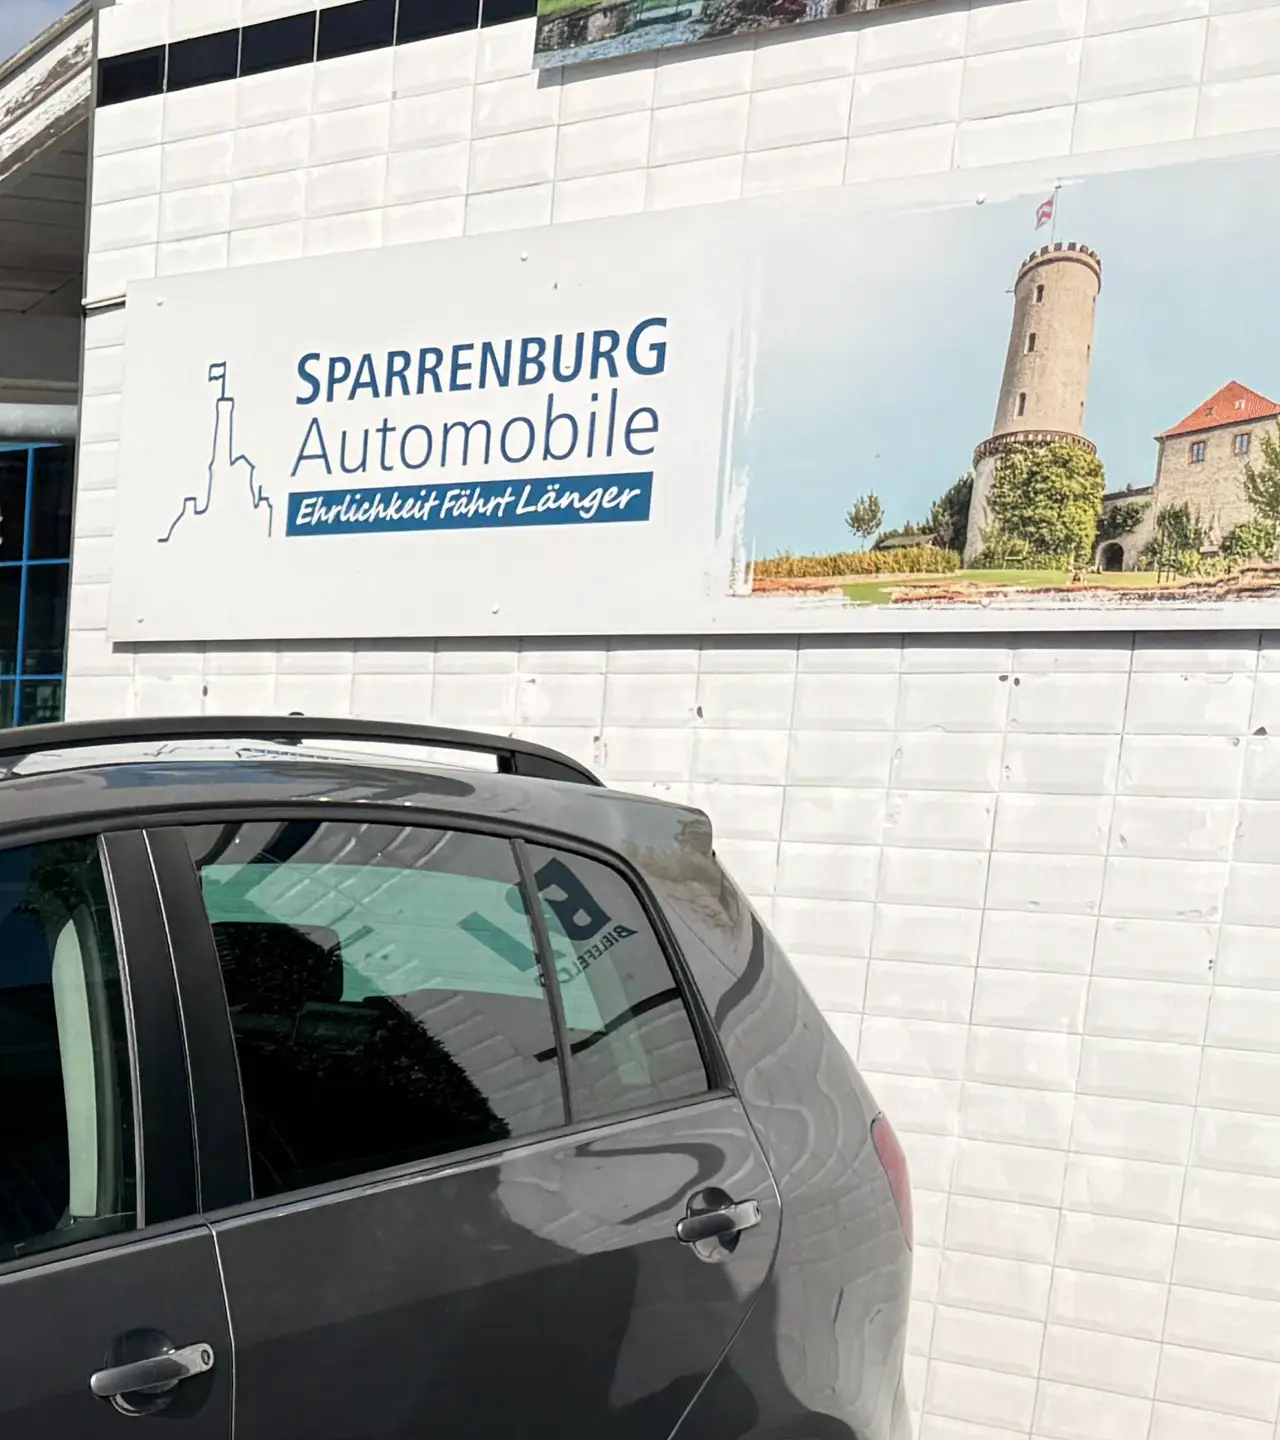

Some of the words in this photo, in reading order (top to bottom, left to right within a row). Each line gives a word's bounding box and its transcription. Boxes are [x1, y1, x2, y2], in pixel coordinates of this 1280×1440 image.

[295, 316, 668, 406] SPARRENBURG
[290, 387, 660, 477] Automobile
[295, 488, 440, 526] Ehrlichkeit
[440, 486, 516, 520] Fährt
[516, 484, 642, 519] Länger
